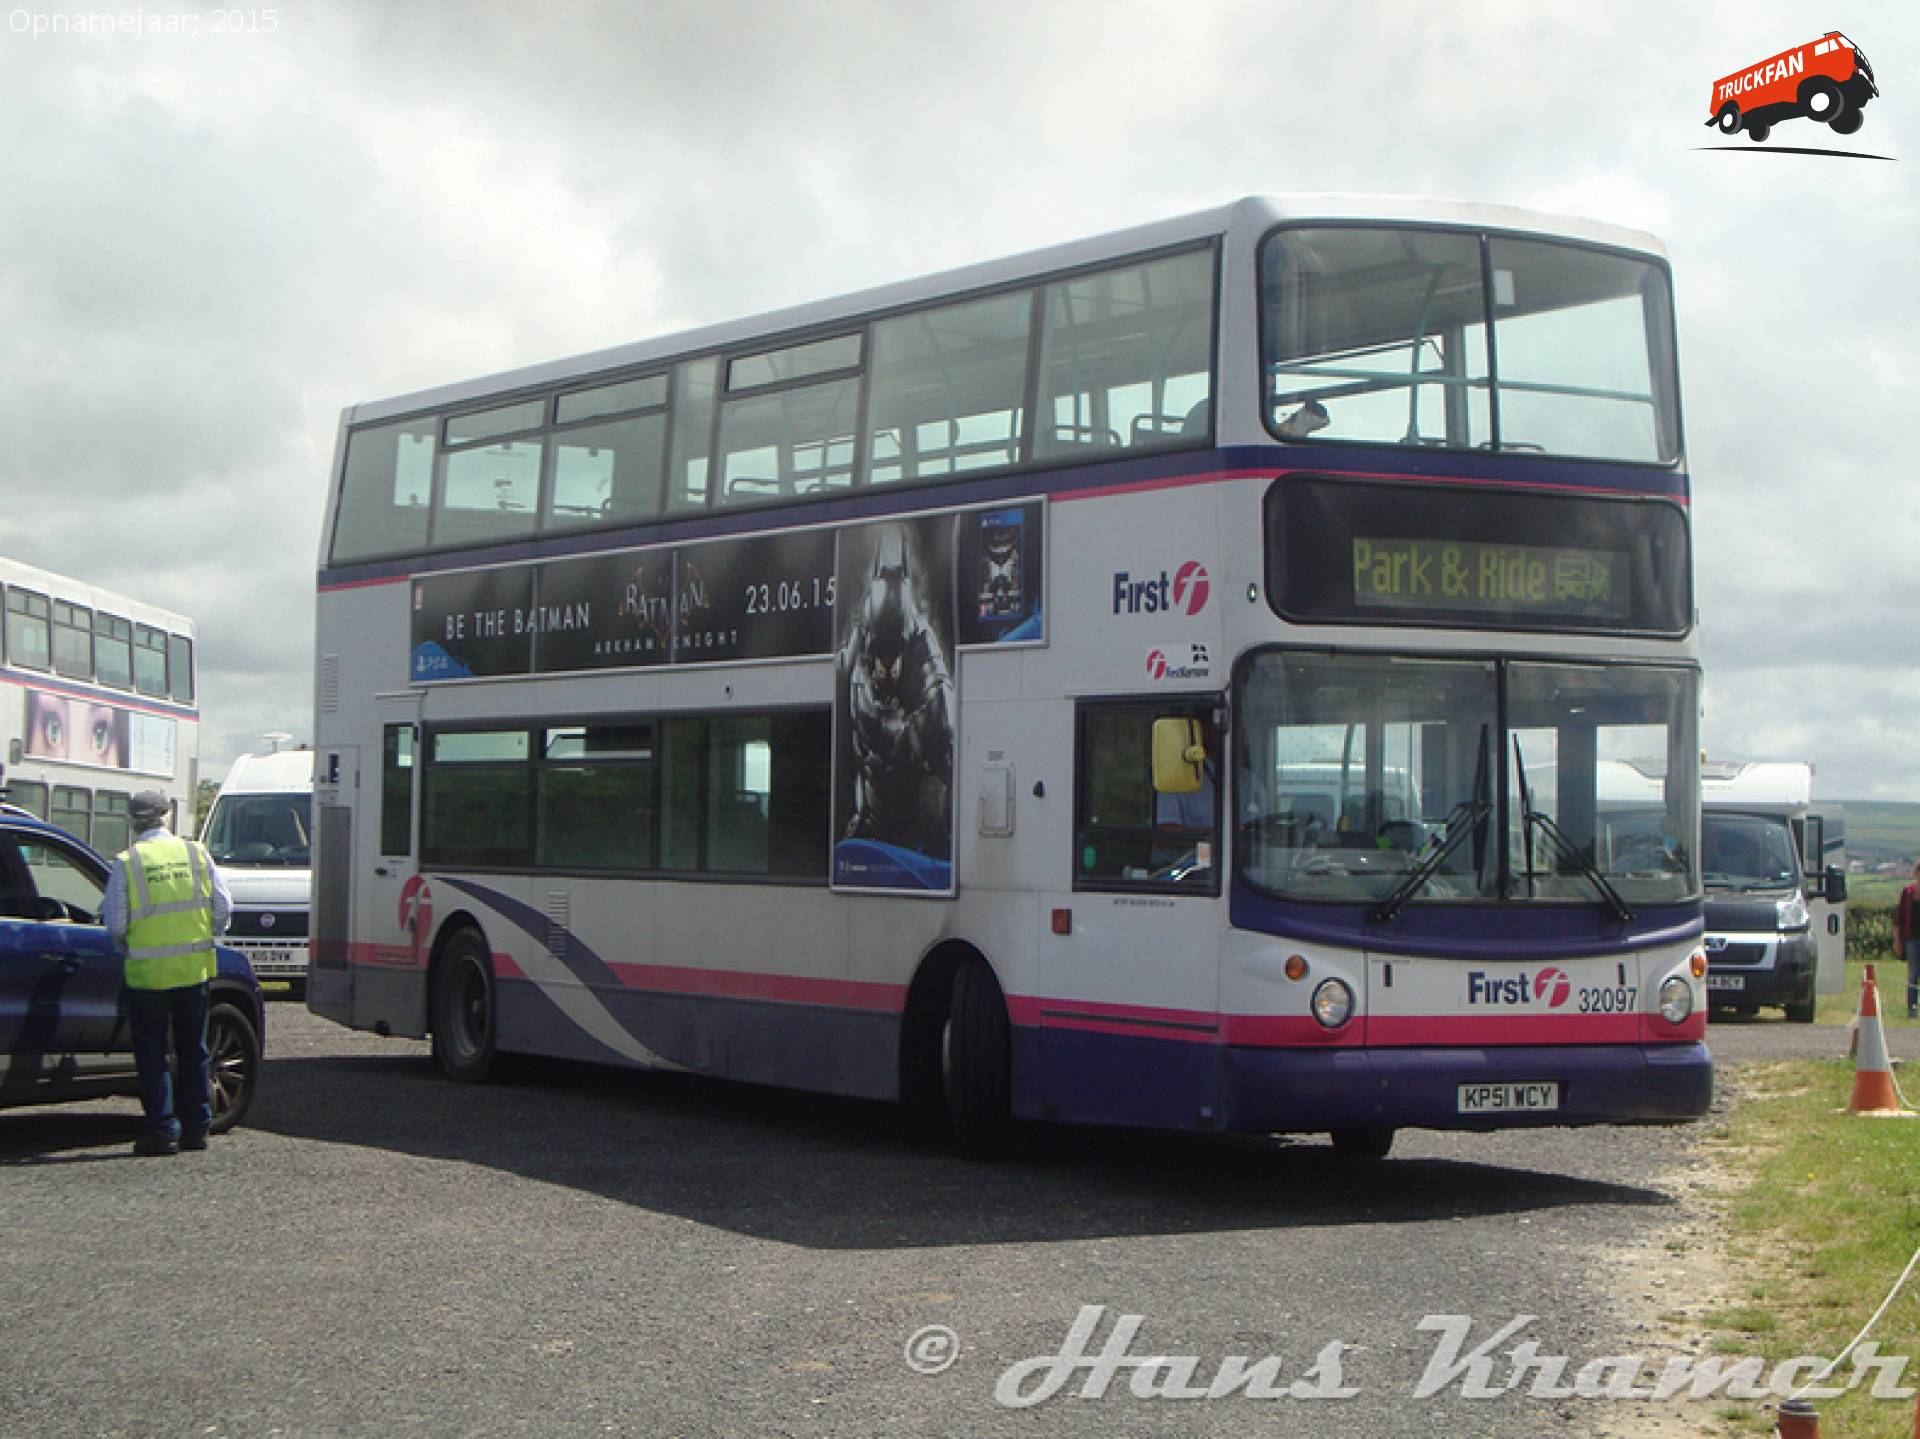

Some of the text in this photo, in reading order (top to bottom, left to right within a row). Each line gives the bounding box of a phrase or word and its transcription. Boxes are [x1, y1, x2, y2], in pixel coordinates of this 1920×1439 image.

[1353, 540, 1547, 601] Park & Ride
[745, 576, 837, 614] 23.06.15
[1112, 570, 1170, 616] First
[446, 602, 591, 640] BE THE BATMAN
[1467, 971, 1530, 1005] First
[1579, 986, 1638, 1013] 32097
[1513, 1085, 1552, 1107] WCY
